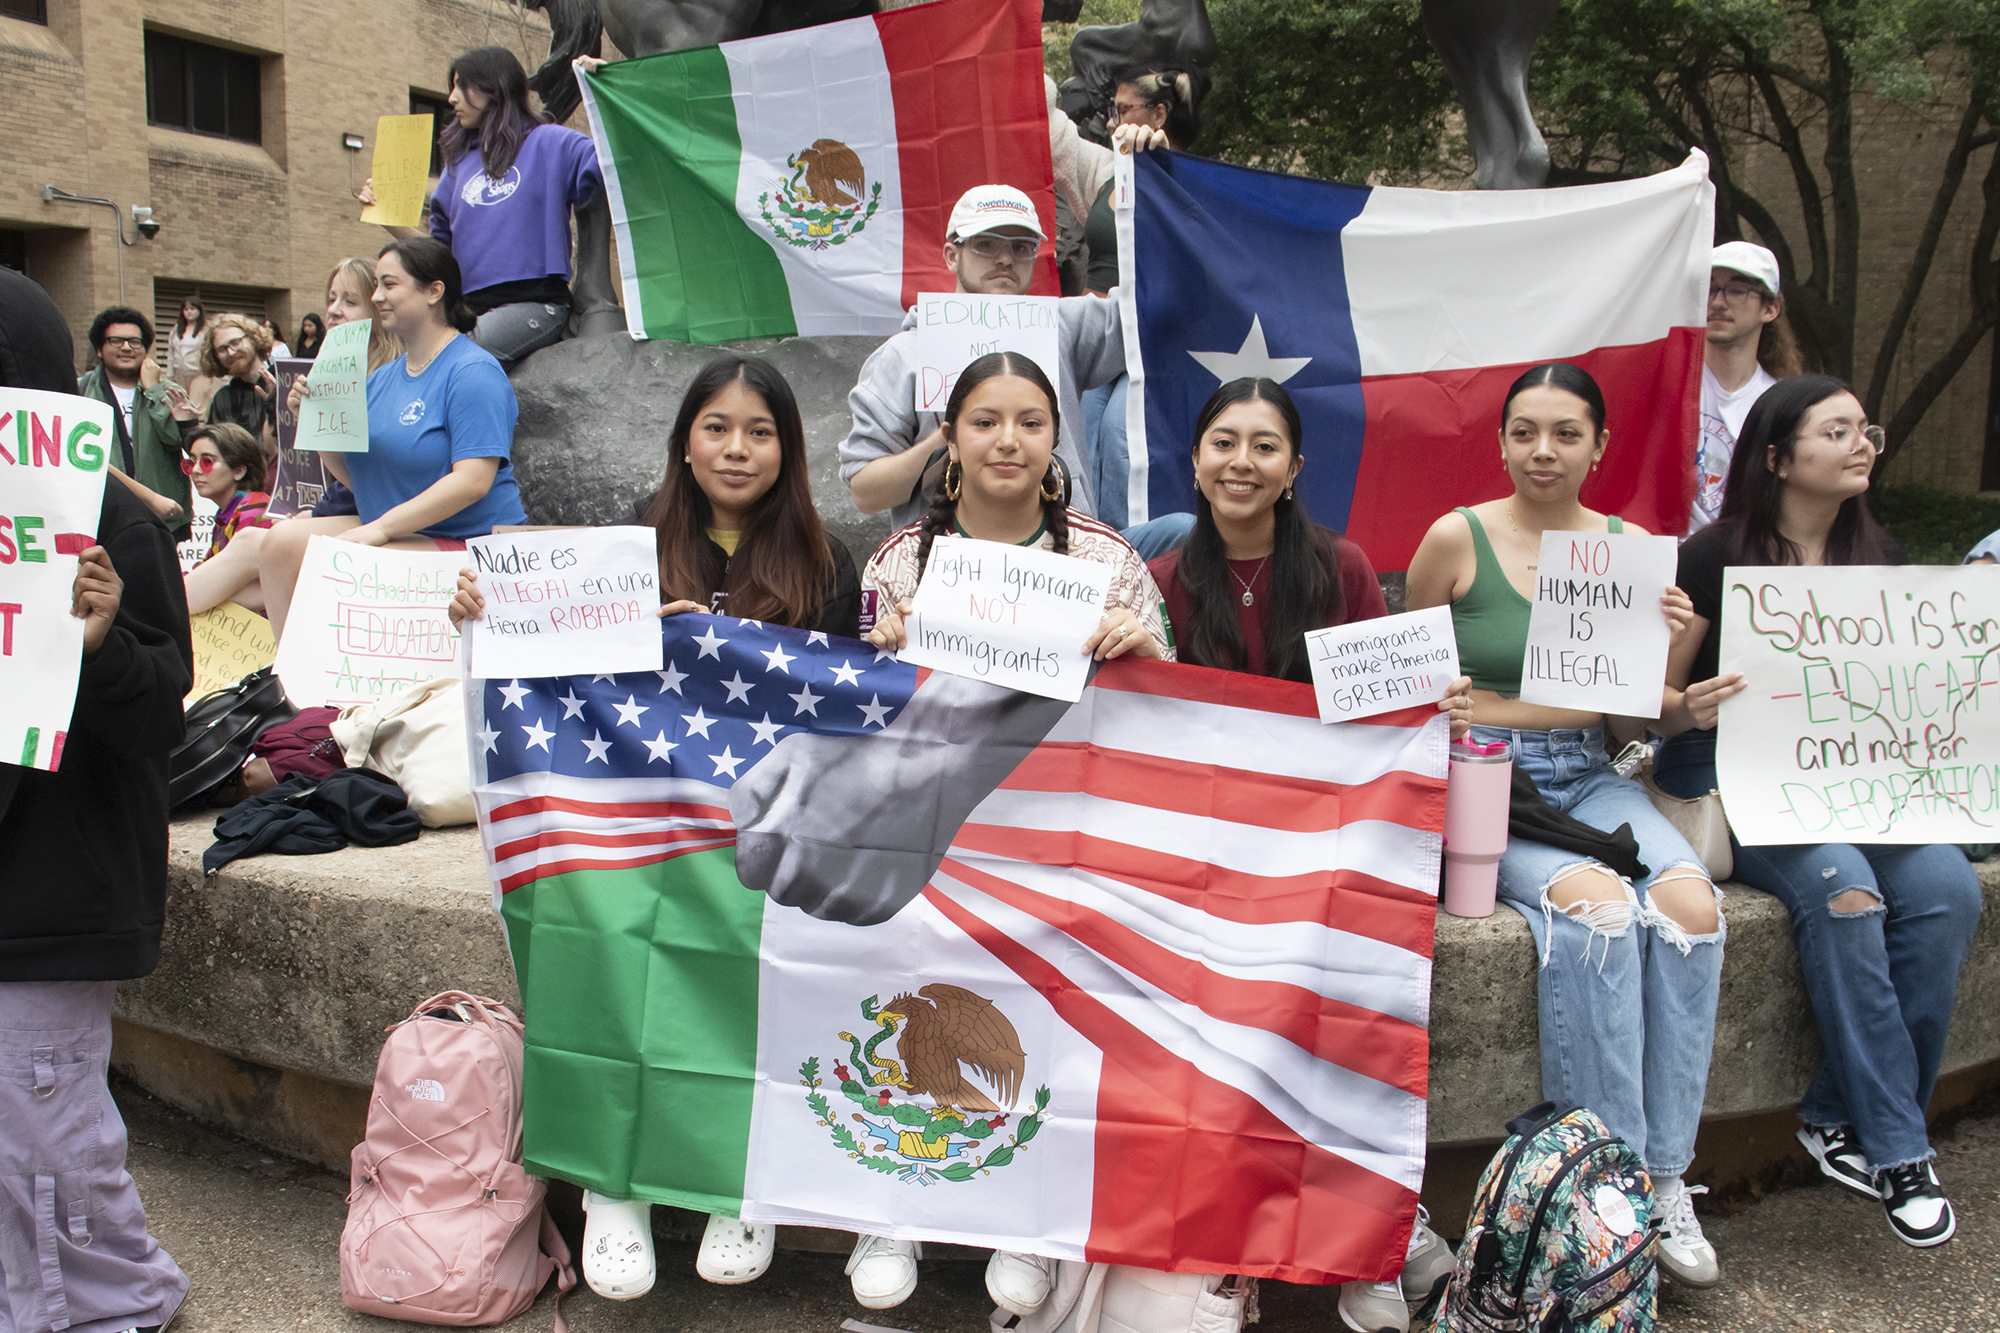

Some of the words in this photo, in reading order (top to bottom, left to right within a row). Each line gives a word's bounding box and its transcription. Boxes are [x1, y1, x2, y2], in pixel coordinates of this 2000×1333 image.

[977, 199, 1028, 212] Sweetwater
[925, 300, 1059, 330] EDUCATION
[471, 544, 542, 575] Nadie
[550, 547, 578, 570] es
[931, 545, 982, 587] Fight
[1002, 553, 1100, 605] Ignorance
[1570, 539, 1610, 576] NO
[332, 551, 411, 602] School
[580, 576, 614, 596] en
[617, 572, 654, 593] una
[1539, 575, 1632, 610] HUMAN
[486, 614, 541, 635] tierra
[550, 600, 641, 634] ROBADA
[970, 593, 1027, 625] NOT
[1569, 611, 1594, 641] IS
[1759, 584, 1895, 653] School
[1951, 591, 2000, 648] for
[347, 609, 452, 655] EDUCATION
[918, 612, 1060, 678] Immigrants
[1308, 625, 1431, 662] Immigrants
[335, 656, 384, 695] And
[1331, 658, 1381, 680] make
[1390, 648, 1450, 670] America
[1530, 645, 1629, 687] ILLEGAL
[1796, 732, 1859, 770] and
[1869, 727, 1918, 763] not
[1925, 723, 1968, 760] for
[405, 1084, 431, 1094] NORTH
[412, 1091, 432, 1101] FACE
[416, 1078, 431, 1087] THE
